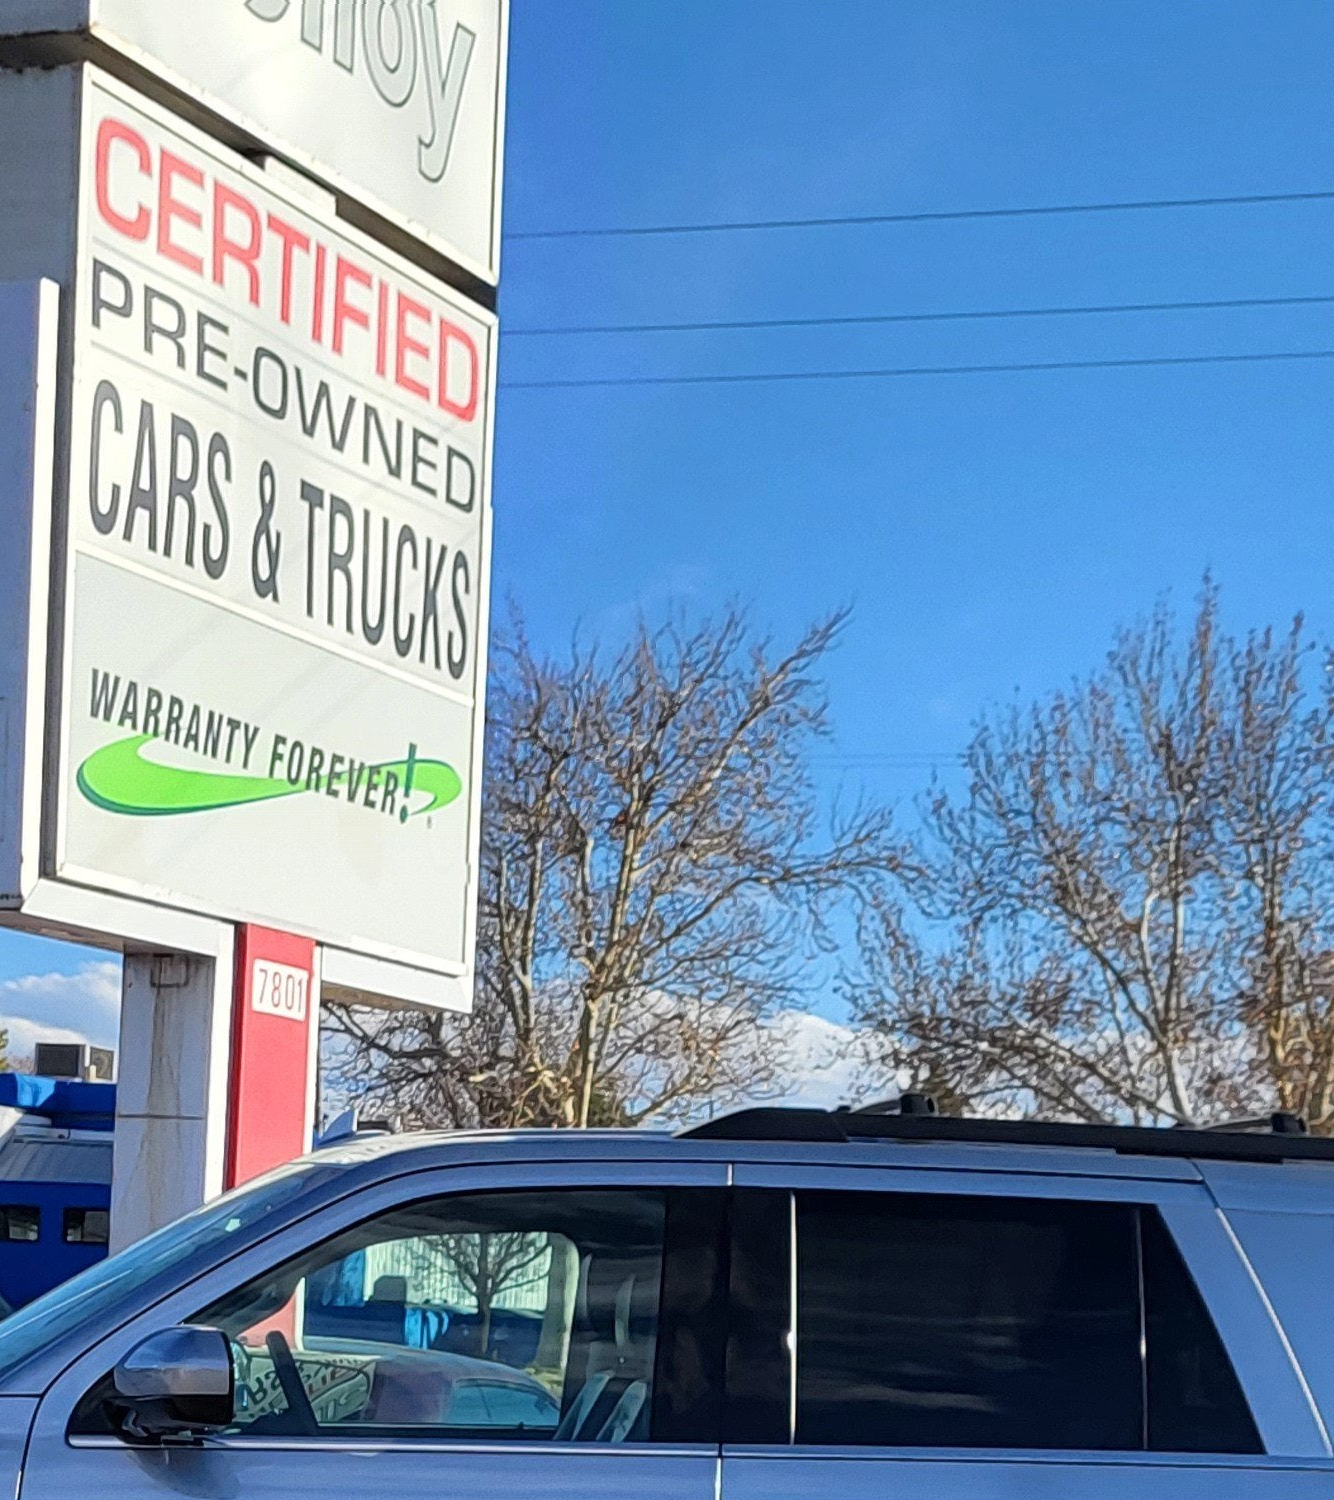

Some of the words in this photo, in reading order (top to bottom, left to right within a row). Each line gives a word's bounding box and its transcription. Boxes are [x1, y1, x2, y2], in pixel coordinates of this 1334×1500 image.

[91, 257, 476, 514] PRE-OWNED
[94, 117, 479, 422] CERTIFIED
[88, 379, 233, 580] CARS
[251, 460, 281, 604] &
[300, 479, 469, 680] TRUCKS
[90, 667, 260, 769] WARRANTY
[268, 733, 417, 825] FOREVER!
[258, 967, 303, 1013] 7801
